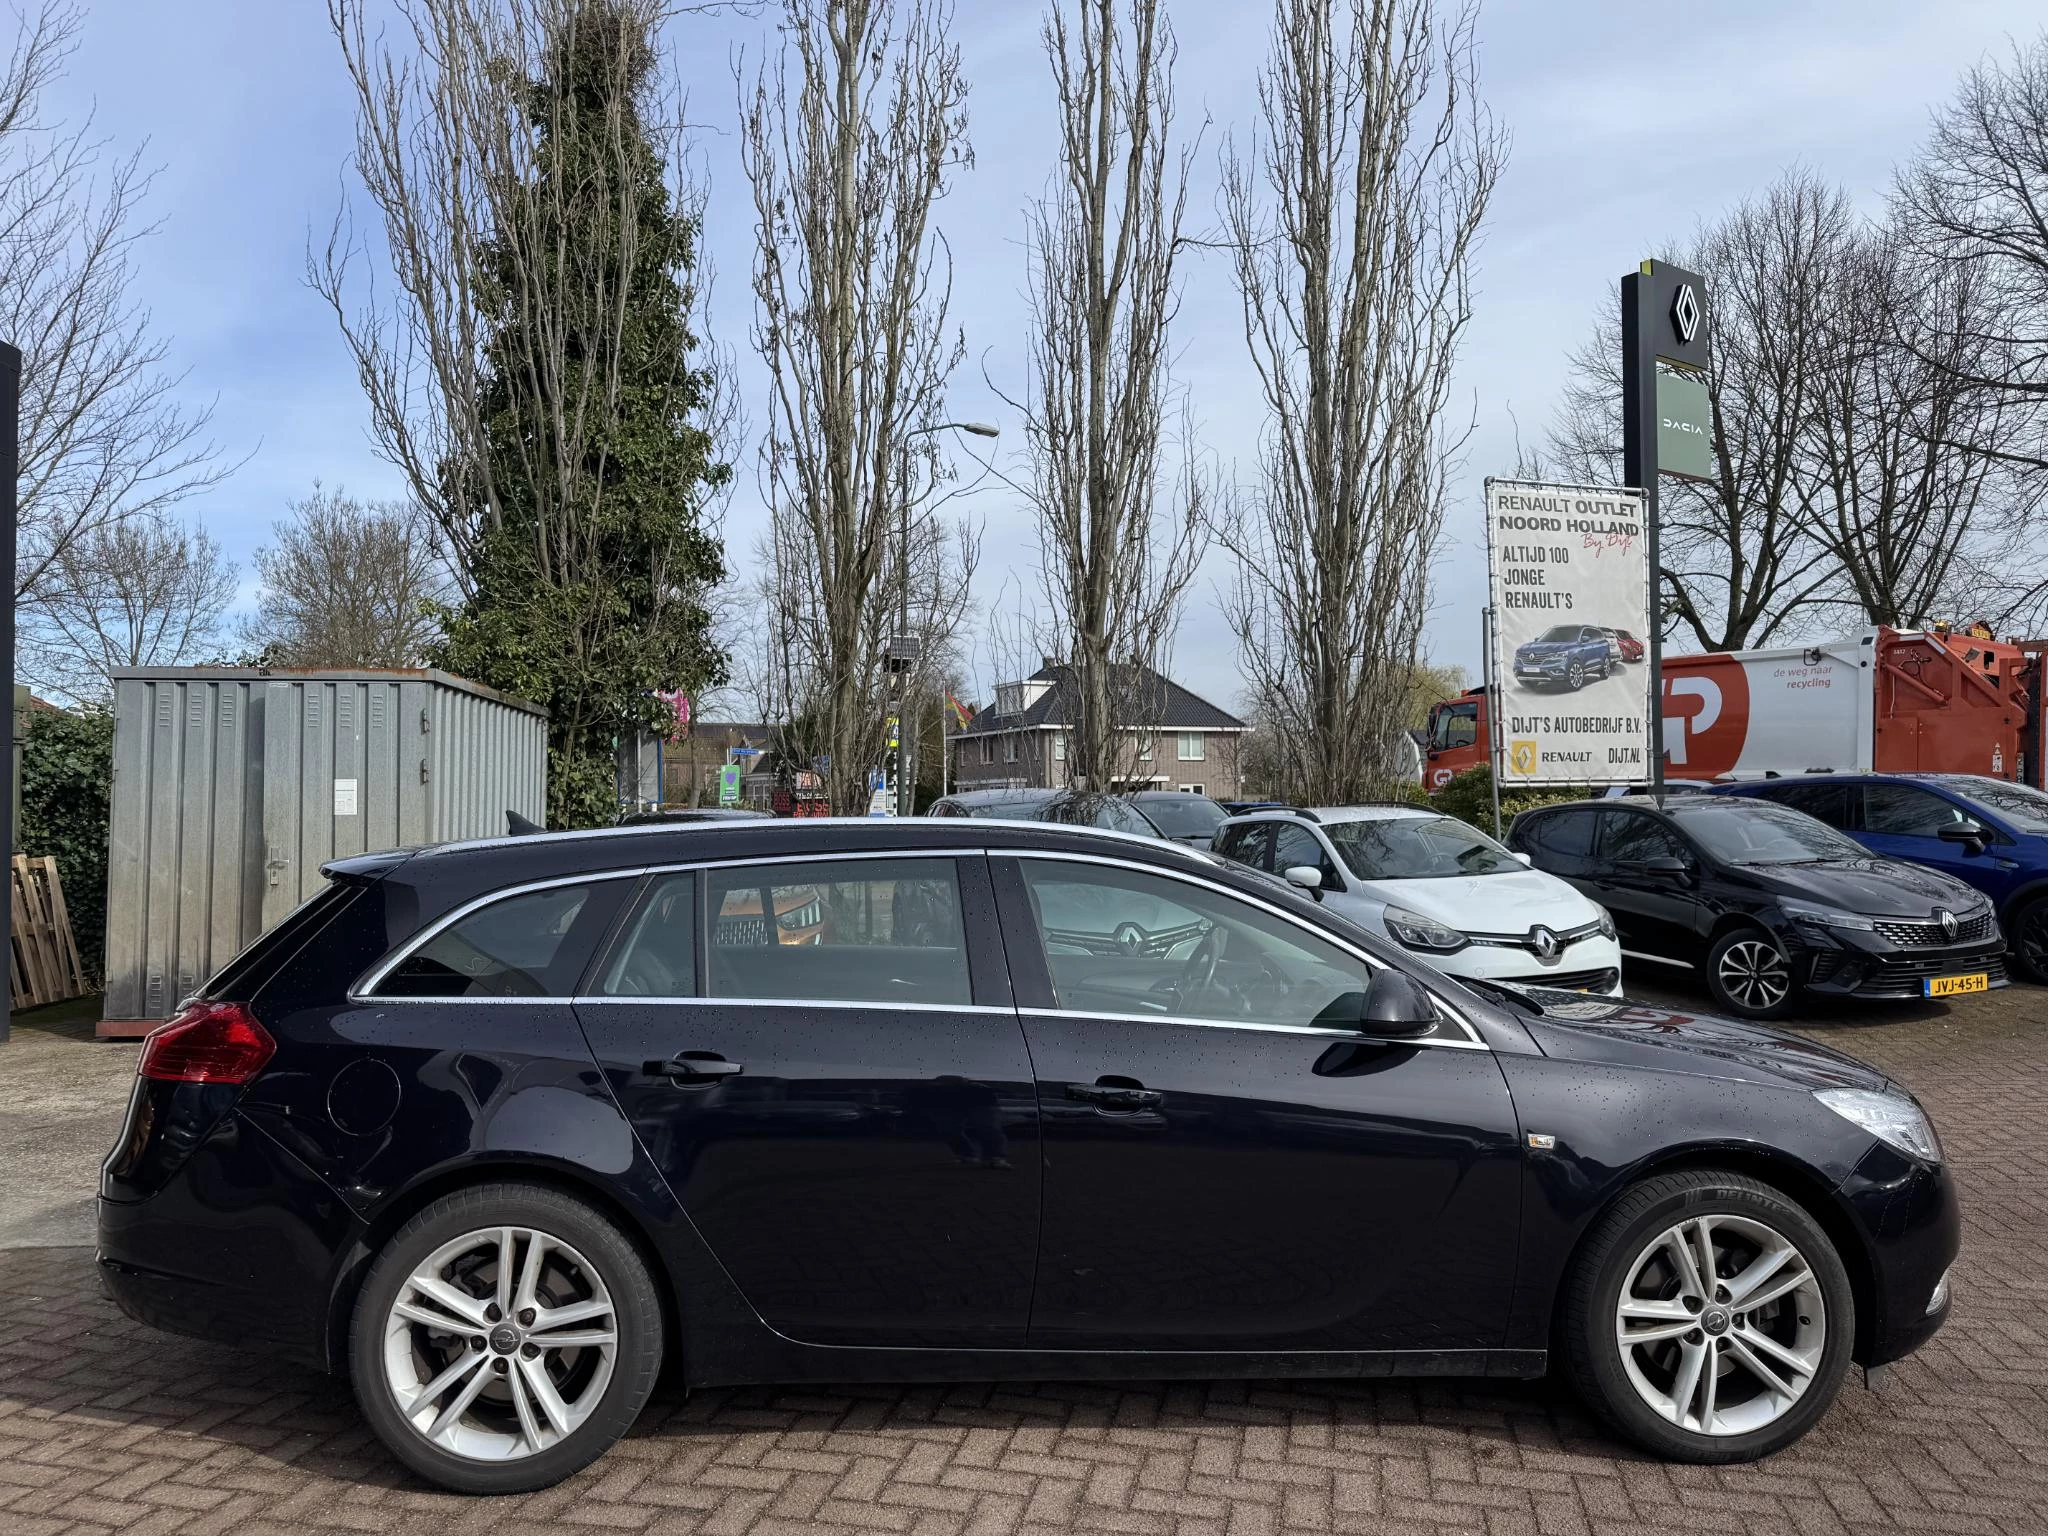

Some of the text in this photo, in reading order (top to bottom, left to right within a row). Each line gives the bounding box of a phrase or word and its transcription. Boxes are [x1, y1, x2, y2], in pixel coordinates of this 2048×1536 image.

[1663, 418, 1703, 435] DACIA
[1498, 495, 1637, 517] RENAULT OUTLET
[1500, 516, 1639, 536] NOORD HOLLAND
[1581, 533, 1604, 558] By
[1503, 546, 1569, 563] ALTIJD 100
[1504, 569, 1545, 585] JONGE
[1505, 592, 1573, 609] RENAULT'S
[1774, 666, 1832, 677] de weg naar
[1787, 678, 1831, 689] recycling
[1512, 717, 1642, 733] DIJT'S AUTOBEDRIJF B.V.
[1541, 748, 1640, 763] RENAULT DIJT.NL
[1935, 976, 1983, 993] JVJ-45-H
